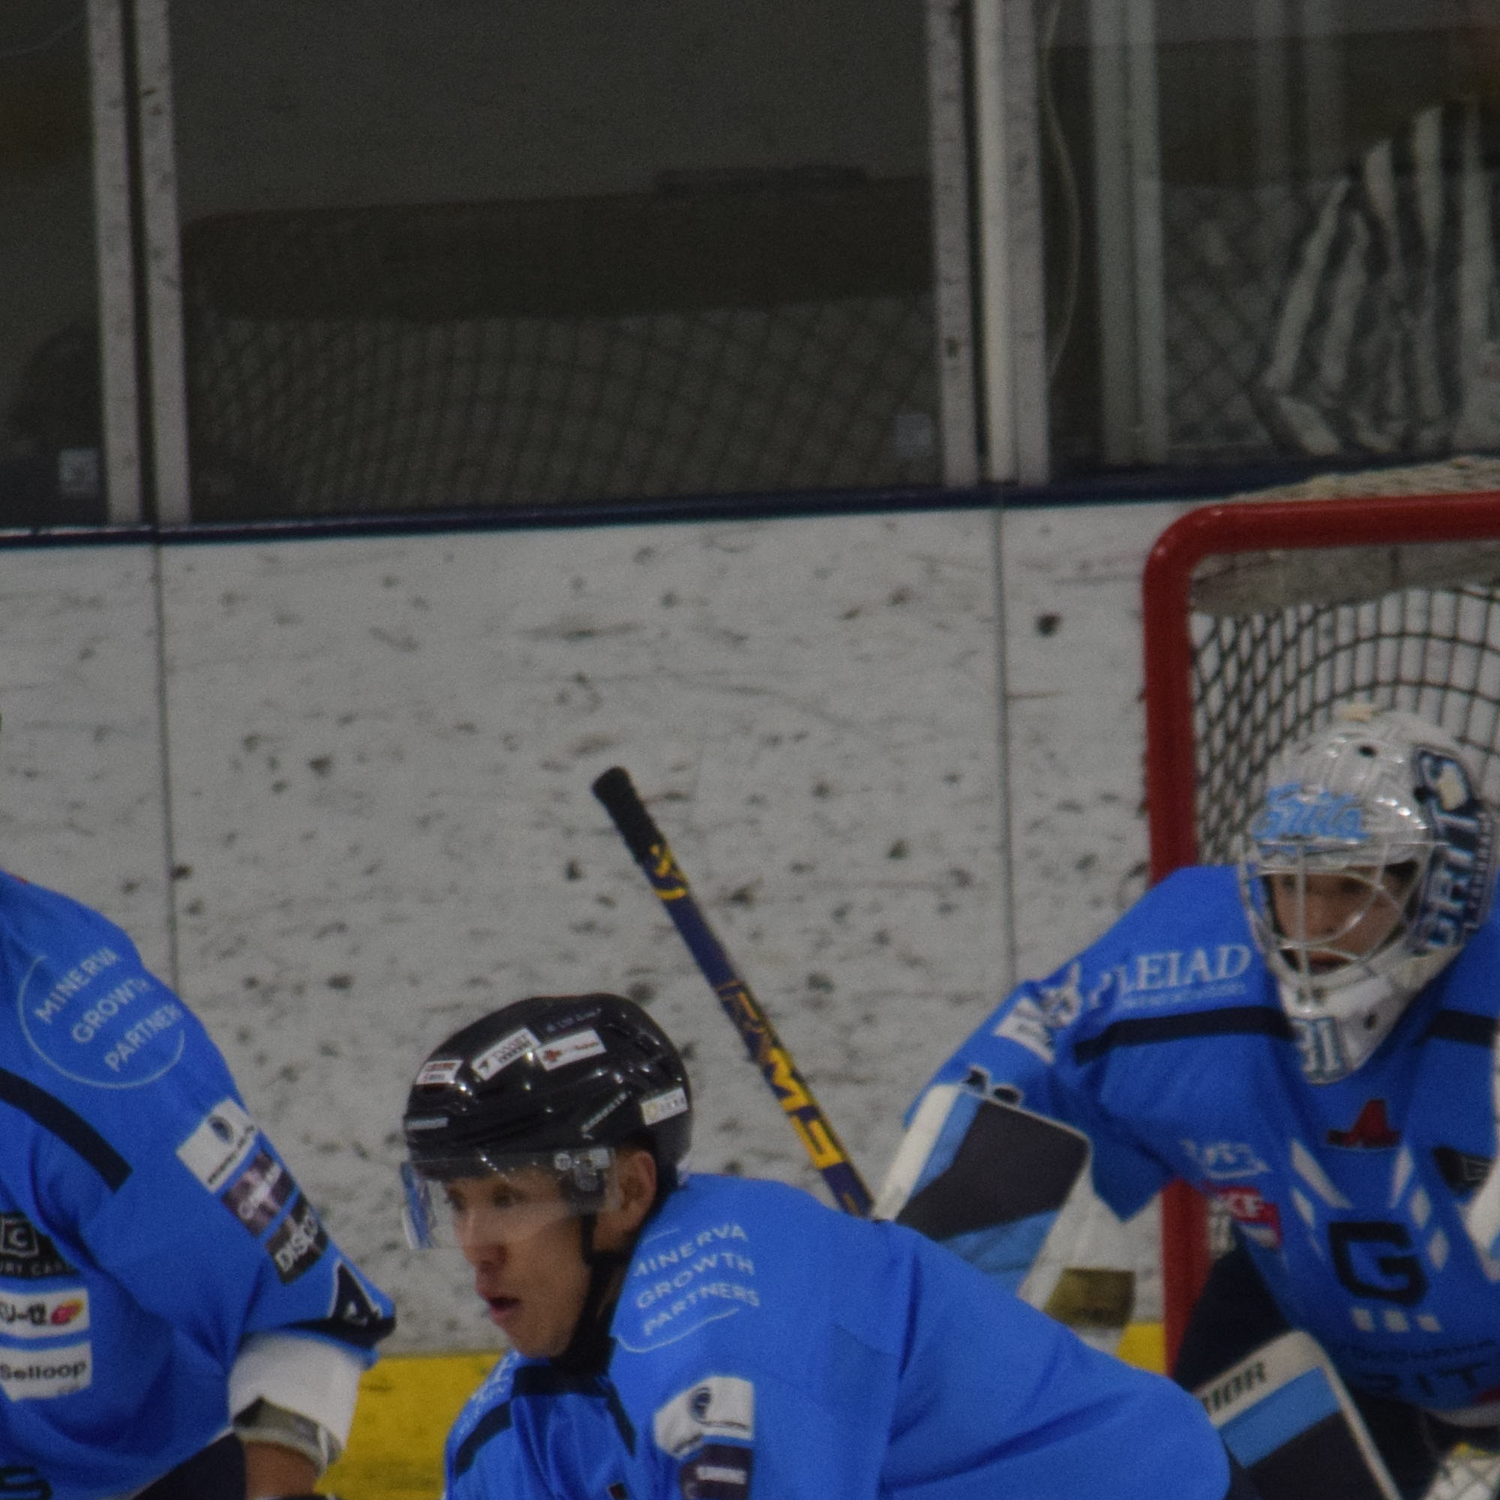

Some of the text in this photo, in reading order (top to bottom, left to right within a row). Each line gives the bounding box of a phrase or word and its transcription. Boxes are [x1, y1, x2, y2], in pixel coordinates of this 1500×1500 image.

[103, 1001, 186, 1074] PARTNER
[635, 1249, 757, 1311] GROWTH
[1328, 1221, 1428, 1307] G
